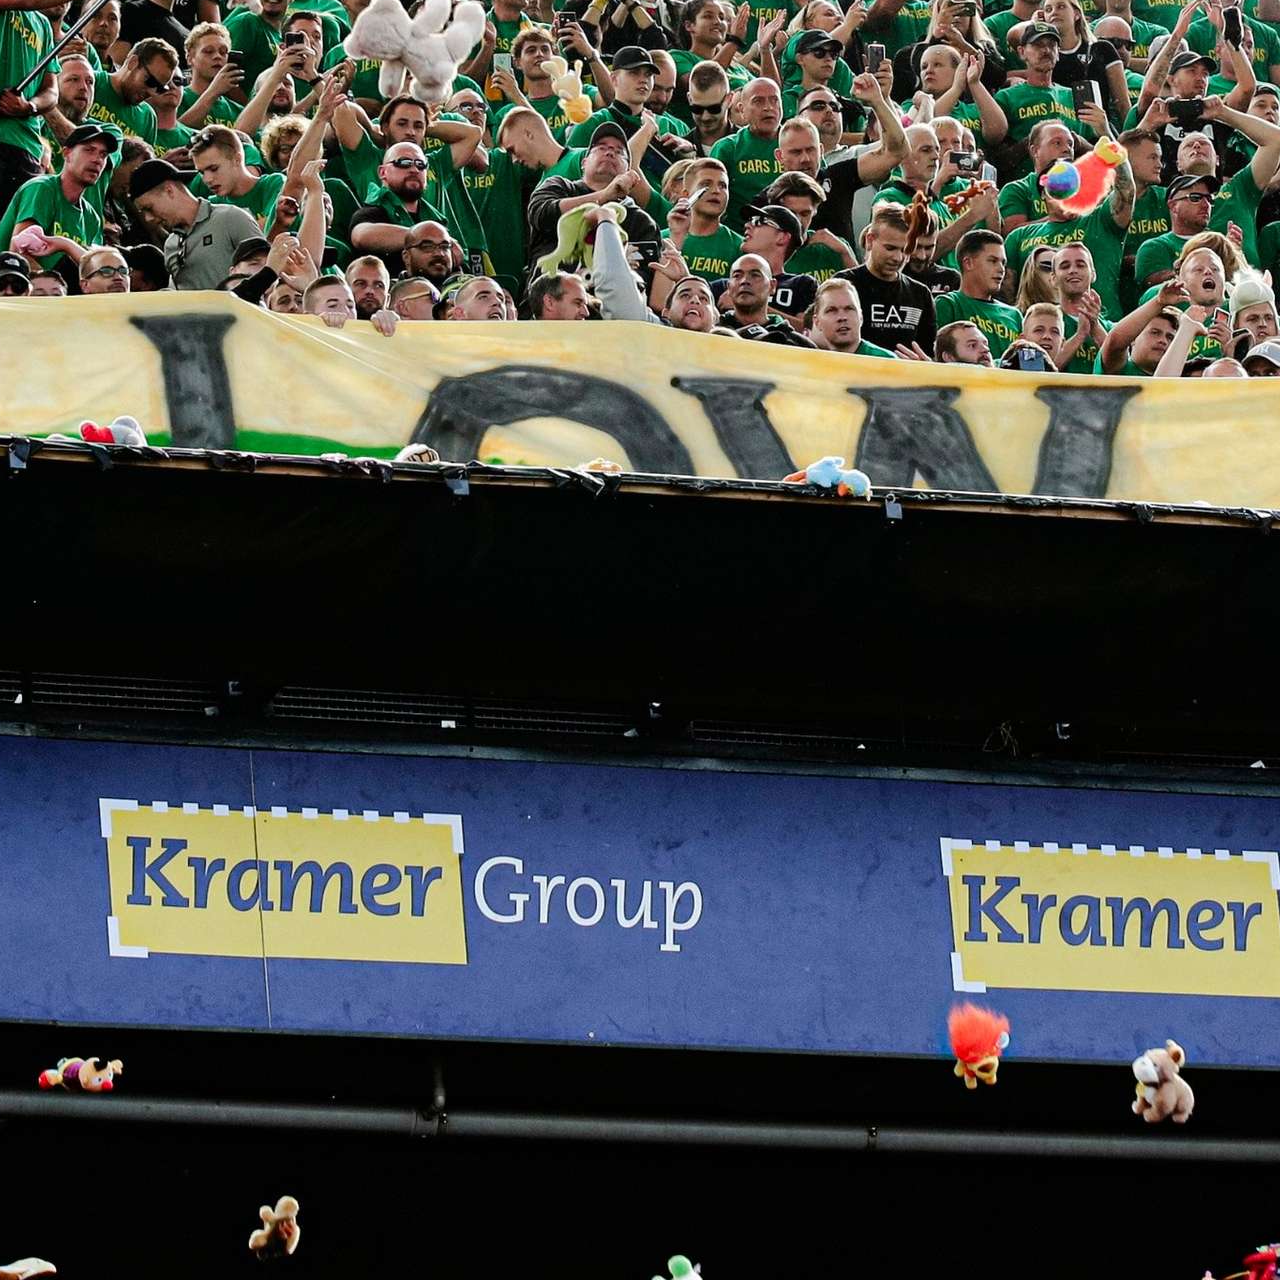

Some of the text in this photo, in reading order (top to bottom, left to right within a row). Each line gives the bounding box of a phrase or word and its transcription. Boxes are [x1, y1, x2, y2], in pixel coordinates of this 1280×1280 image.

[1019, 104, 1048, 120] CARS
[740, 159, 772, 175] CARS
[690, 256, 730, 276] JEANS
[1202, 336, 1221, 351] JEA
[126, 835, 703, 952] Kramer Group
[962, 874, 1263, 952] Kramer
